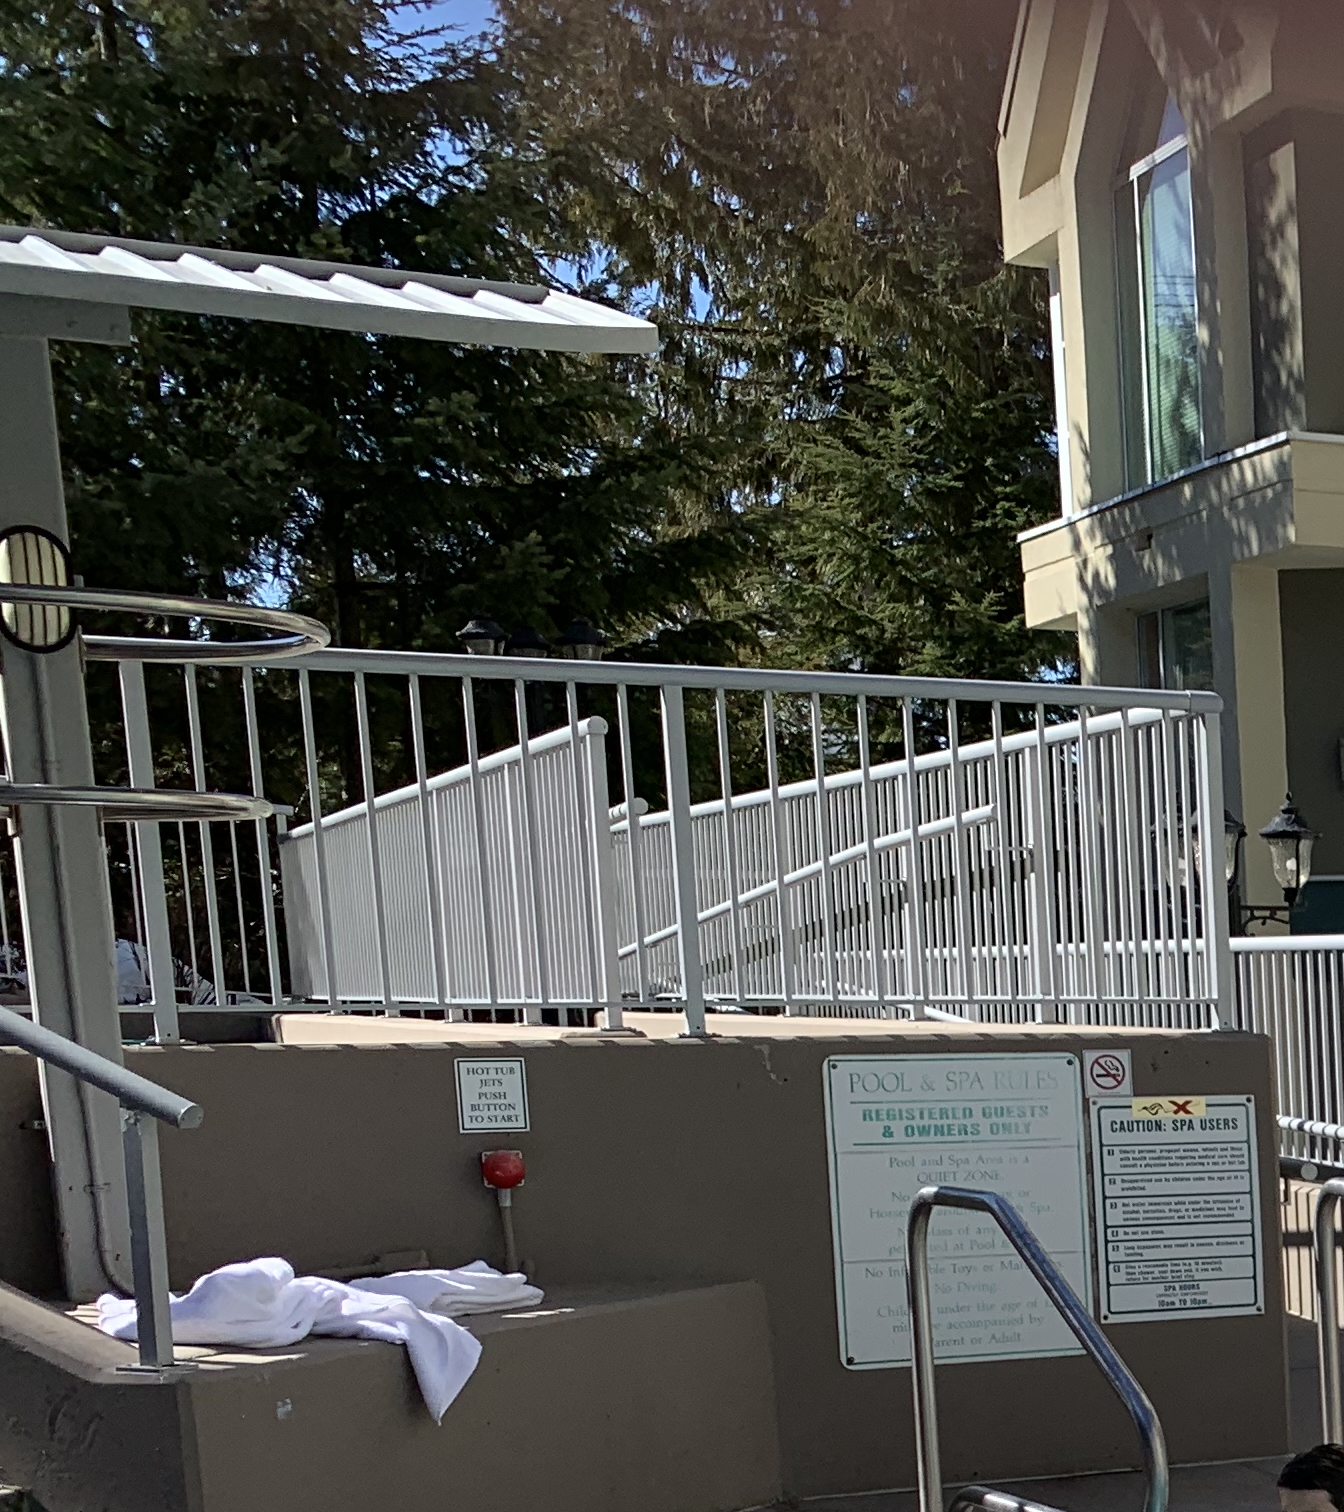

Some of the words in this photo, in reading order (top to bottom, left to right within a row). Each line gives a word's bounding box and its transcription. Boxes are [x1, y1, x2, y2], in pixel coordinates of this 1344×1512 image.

[466, 1067, 491, 1076] HOT
[493, 1067, 516, 1075] TUB
[479, 1079, 503, 1089] JETS
[849, 1072, 912, 1094] POOL
[920, 1073, 935, 1092] &
[946, 1071, 984, 1092] SPA
[995, 1071, 1059, 1091] RULES
[478, 1092, 507, 1100] PUSH
[470, 1103, 516, 1112] BUTTON
[862, 1106, 973, 1122] REGISTERED
[982, 1105, 1049, 1120] GUESTS
[468, 1115, 485, 1123] TO
[487, 1114, 520, 1123] START
[1110, 1120, 1167, 1133] CAUTION:
[1172, 1119, 1195, 1132] SPA
[1200, 1117, 1239, 1131] USERS
[882, 1125, 895, 1138] &
[904, 1122, 981, 1138] OWNERS
[990, 1121, 1032, 1136] ONLY
[889, 1155, 915, 1168] Pool
[921, 1154, 943, 1166] and
[948, 1154, 970, 1168] Spa
[976, 1154, 1002, 1165] Area
[917, 1170, 959, 1185] QUIET
[891, 1191, 910, 1204] No
[927, 1226, 952, 1236] lass
[958, 1225, 970, 1236] of
[975, 1225, 996, 1238] any
[953, 1242, 964, 1251] at
[970, 1240, 996, 1251] Pool
[865, 1267, 884, 1279] No
[952, 1263, 976, 1277] Toys
[934, 1282, 952, 1293] No
[936, 1303, 970, 1314] under
[976, 1301, 994, 1312] the
[1001, 1301, 1021, 1314] age
[1025, 1298, 1039, 1309] of
[946, 1315, 1024, 1330] accompanied
[1028, 1313, 1044, 1326] by
[970, 1336, 982, 1345] or
